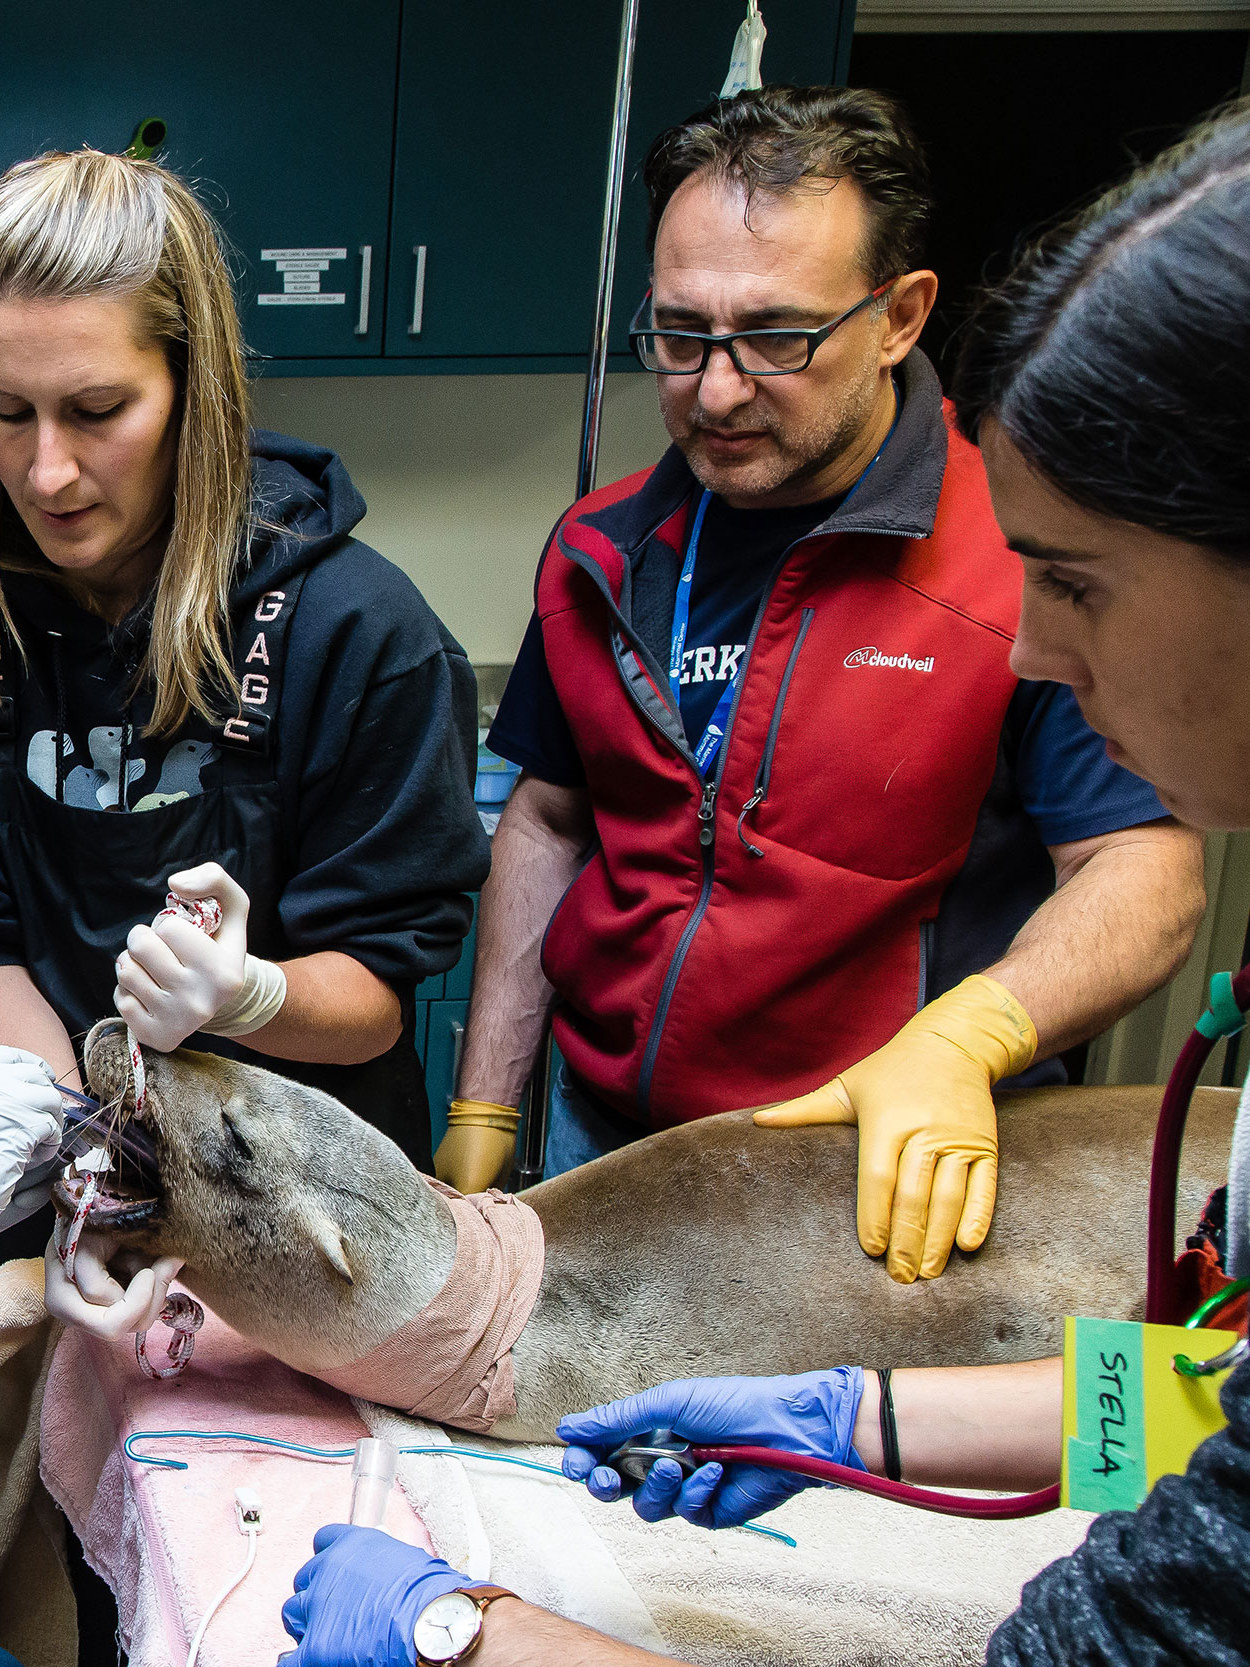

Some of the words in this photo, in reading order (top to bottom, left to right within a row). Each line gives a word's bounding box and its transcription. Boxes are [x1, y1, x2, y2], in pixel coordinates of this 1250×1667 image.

[222, 590, 286, 743] GAGE
[870, 652, 934, 672] cloudveil
[1092, 1352, 1128, 1478] STELLA
